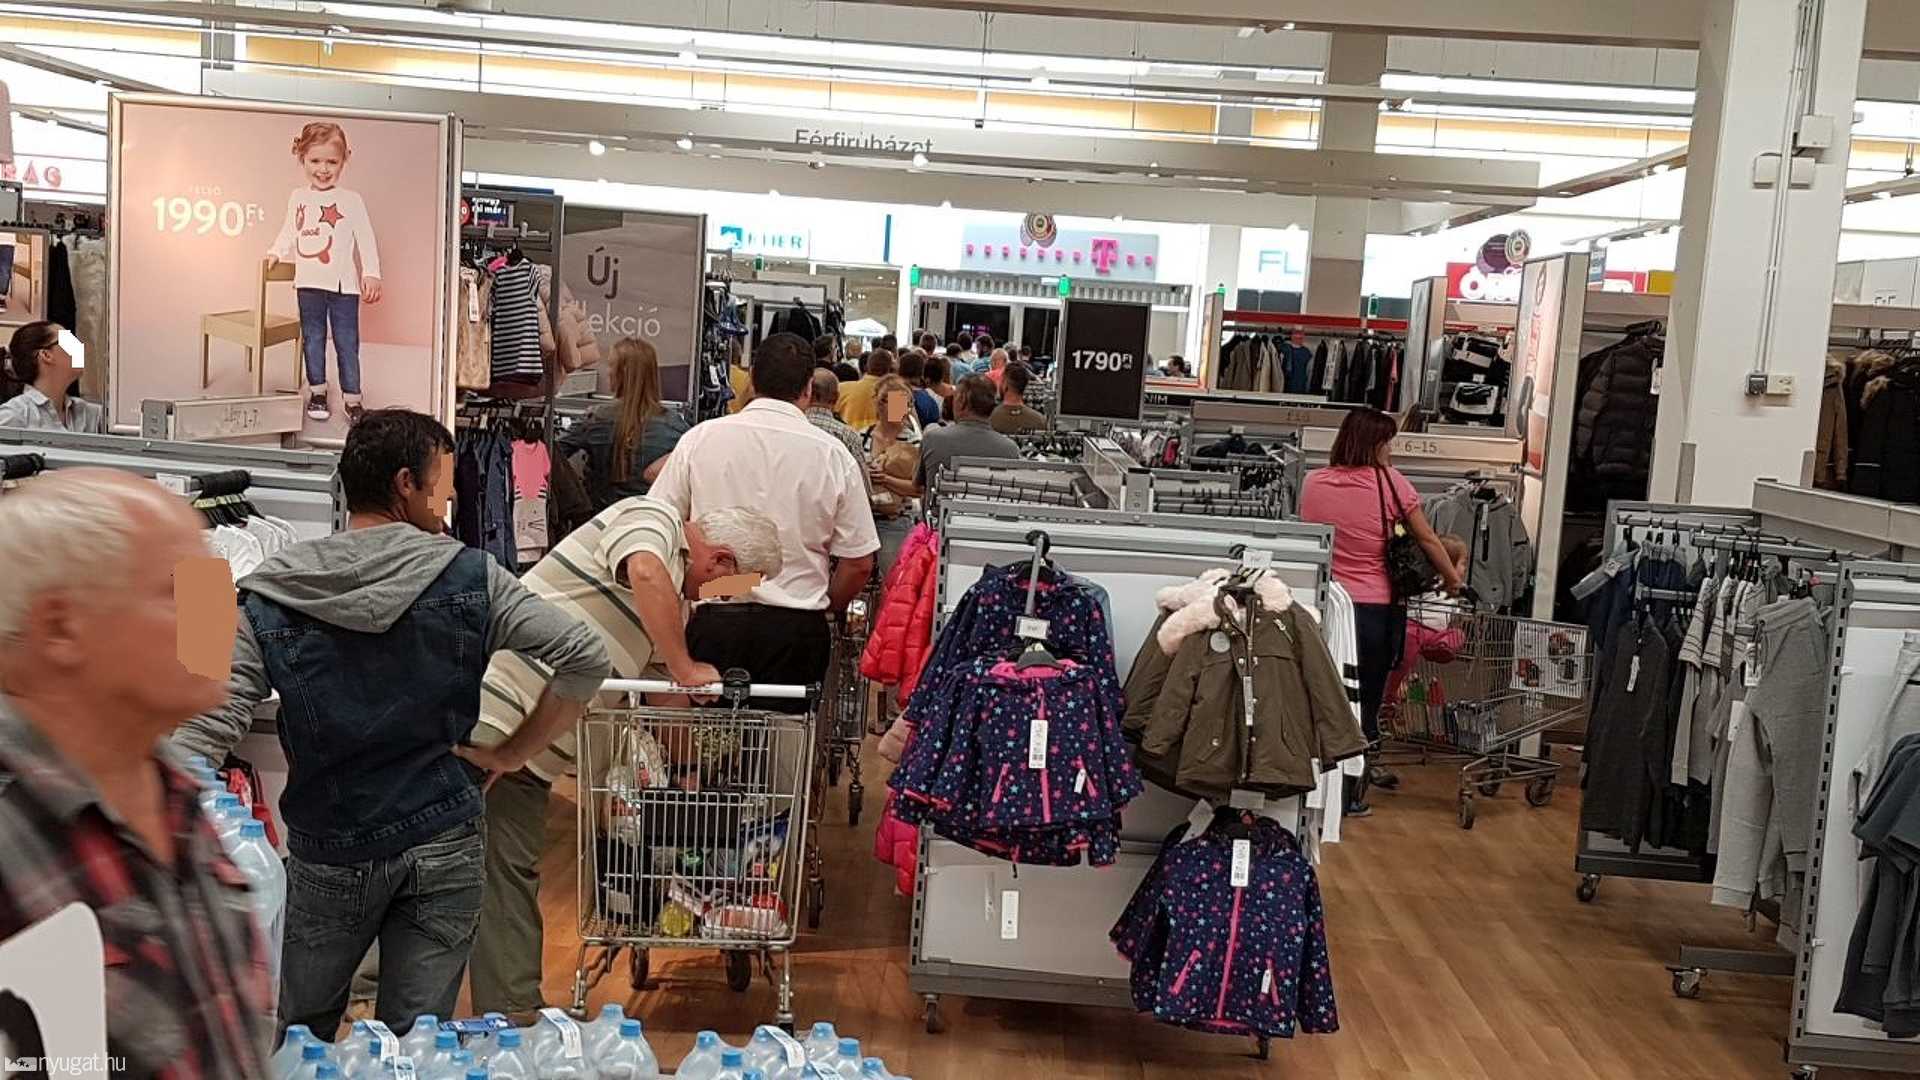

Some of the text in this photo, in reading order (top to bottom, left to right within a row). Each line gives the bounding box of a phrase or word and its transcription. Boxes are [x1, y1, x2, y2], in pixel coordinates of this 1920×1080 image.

[795, 128, 934, 154] Férfiruházat
[152, 196, 244, 237] 1990
[587, 246, 619, 300] Új
[1072, 349, 1122, 372] 1790
